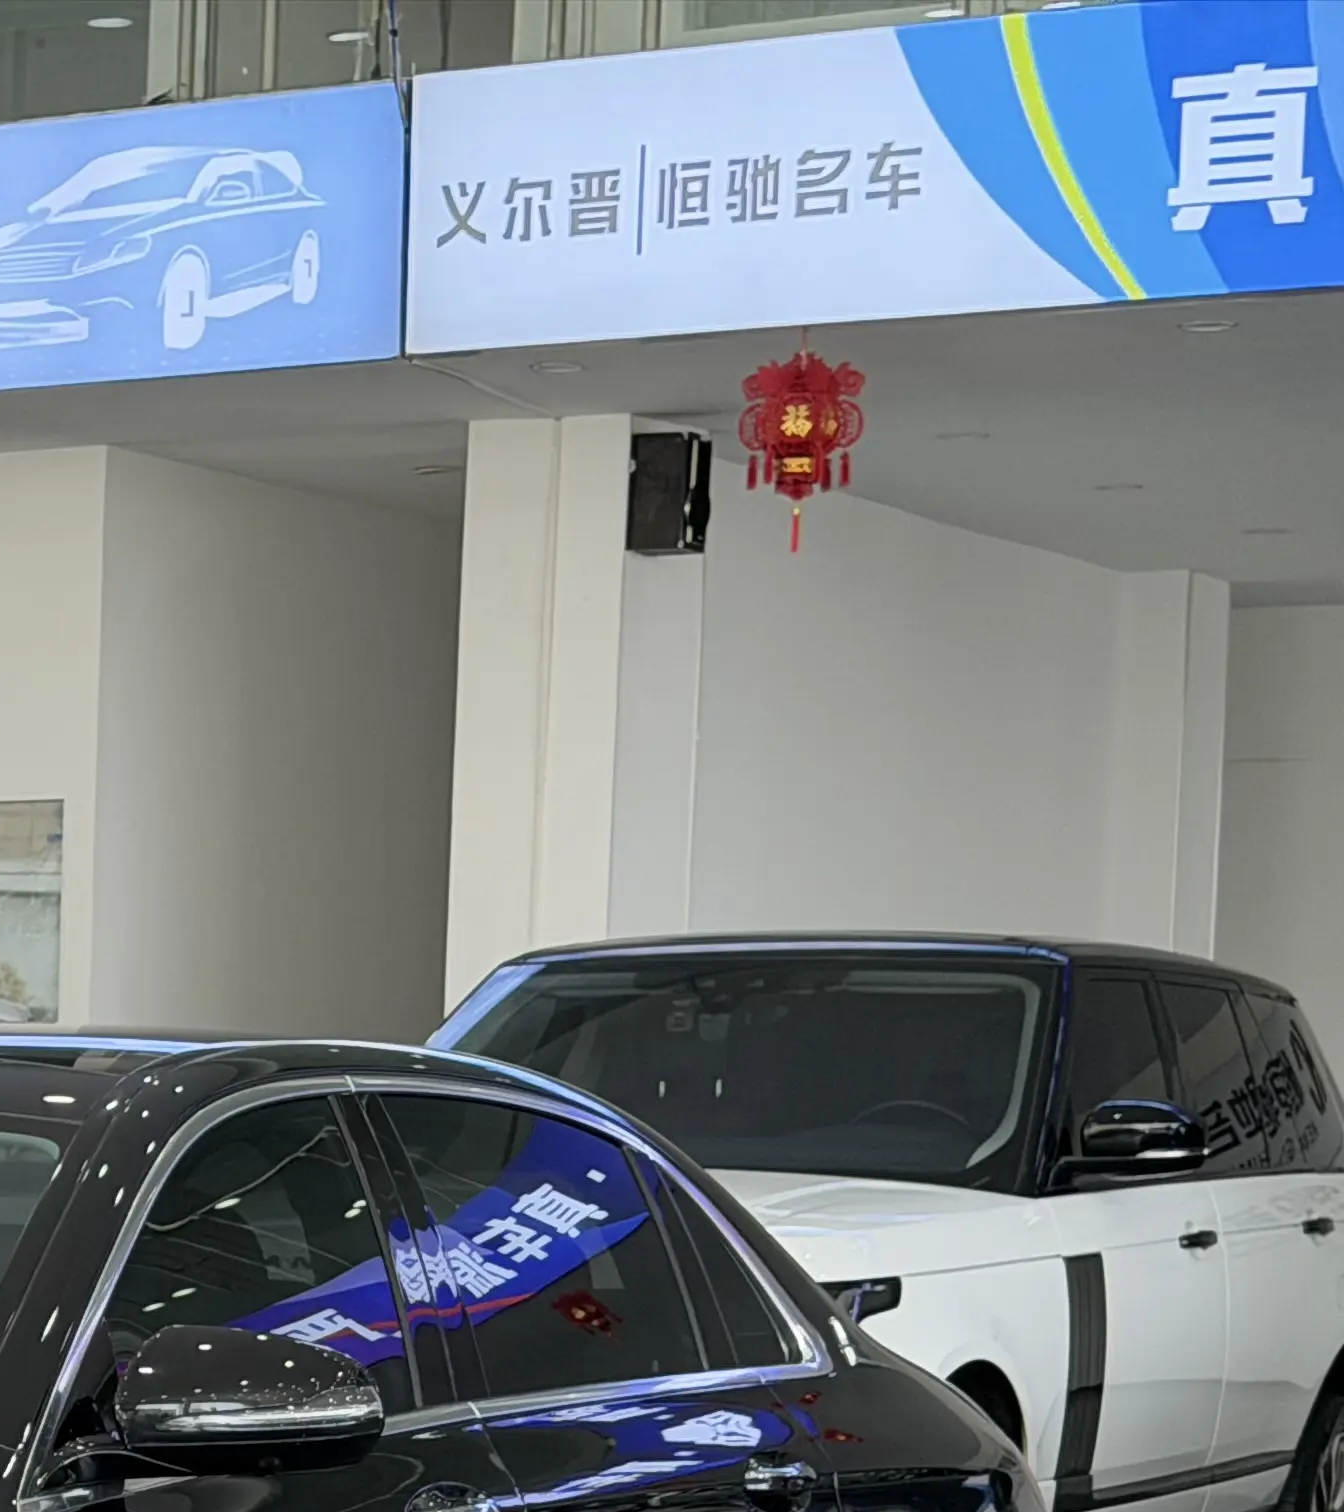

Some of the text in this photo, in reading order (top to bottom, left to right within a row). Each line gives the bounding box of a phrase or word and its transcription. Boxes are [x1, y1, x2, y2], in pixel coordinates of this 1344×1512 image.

[436, 141, 924, 249] 义尔晋 恒驰名车
[1167, 62, 1319, 232] 真
